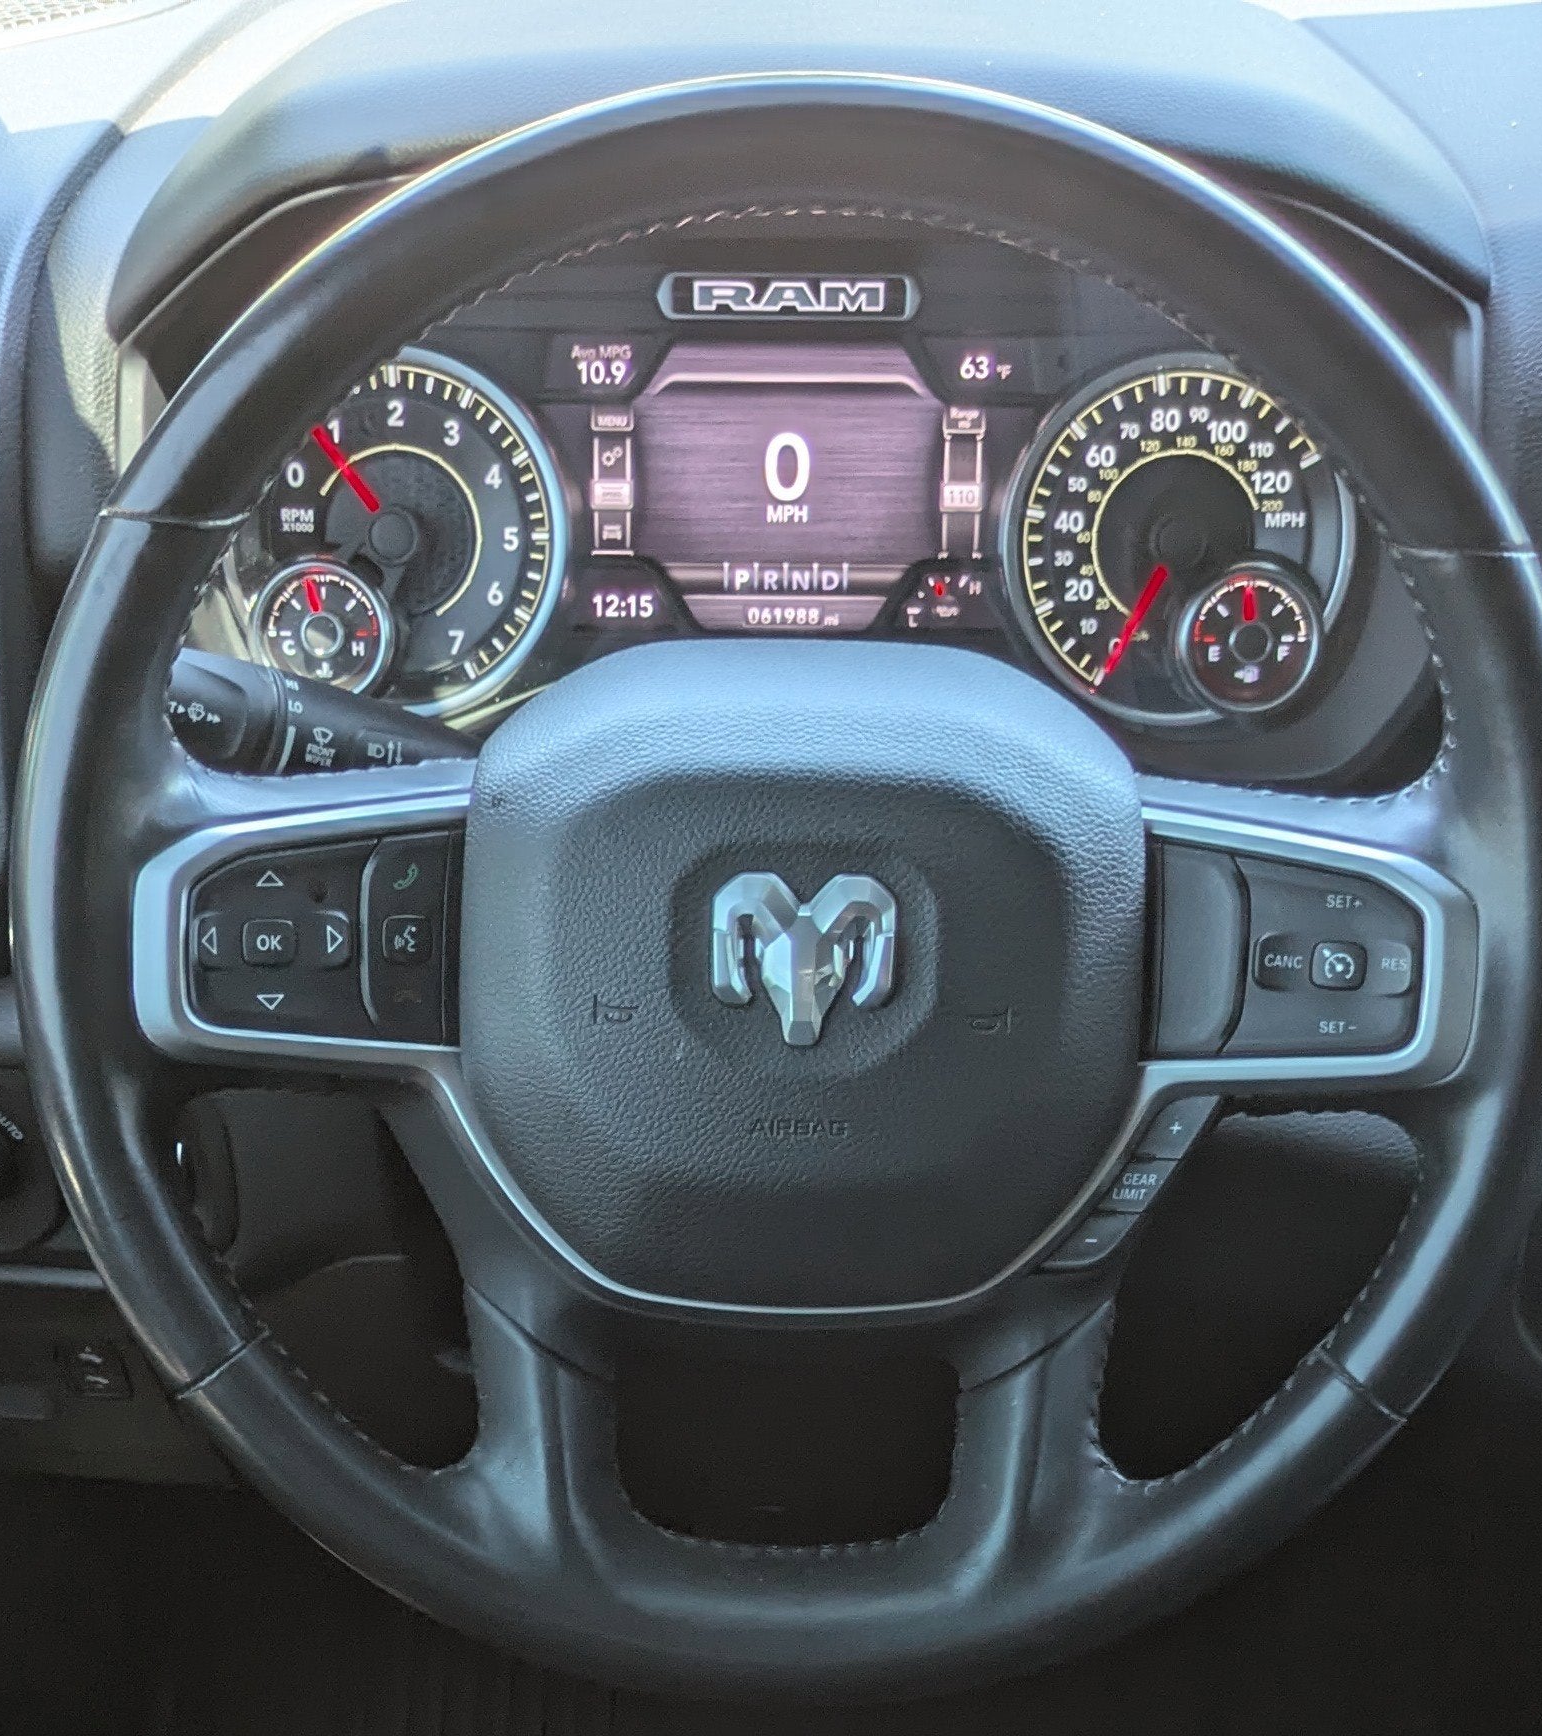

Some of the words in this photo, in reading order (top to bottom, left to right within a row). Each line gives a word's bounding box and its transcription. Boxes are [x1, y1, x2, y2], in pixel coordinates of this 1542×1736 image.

[691, 280, 886, 313] RAM
[599, 344, 632, 360] MPG
[577, 360, 627, 385] 10.9
[960, 355, 990, 379] 63
[387, 400, 404, 427] 2
[1149, 407, 1182, 433] 80
[1189, 406, 1210, 424] 90
[327, 419, 341, 444] 1
[443, 419, 460, 447] 3
[1119, 421, 1140, 440] 70
[1207, 420, 1249, 444] 100
[1140, 439, 1162, 453] 120
[1214, 444, 1236, 457] 160
[1248, 441, 1275, 459] 110
[1085, 444, 1117, 468] 60
[286, 461, 305, 488] 0
[765, 431, 810, 501] 0
[484, 463, 503, 490] 4
[1067, 476, 1088, 493] 50
[1250, 470, 1293, 495] 120
[948, 490, 976, 504] 110
[1260, 499, 1285, 513] 200
[280, 508, 314, 523] RPM
[766, 504, 809, 524] MPH
[1054, 510, 1085, 534] 40
[1264, 511, 1307, 529] MPH
[503, 526, 520, 551] 5
[1054, 549, 1074, 567] 30
[735, 569, 750, 591] P
[763, 570, 779, 591] R
[791, 570, 809, 591] N
[822, 570, 840, 591] D
[487, 580, 504, 606] 6
[1064, 578, 1095, 602] 20
[592, 593, 654, 618] 12:15
[747, 606, 820, 625] 061988
[1079, 618, 1098, 635] 10
[282, 639, 297, 656] C
[351, 641, 366, 657] H
[447, 630, 465, 656] 7
[1208, 644, 1221, 662] E
[1277, 644, 1291, 662] F
[256, 935, 283, 951] OK
[1264, 953, 1303, 969] CANC
[1381, 957, 1408, 972] RES
[746, 1117, 850, 1139] AIRBAG
[1122, 1173, 1158, 1187] GEAR
[1112, 1187, 1147, 1200] LIMIT
